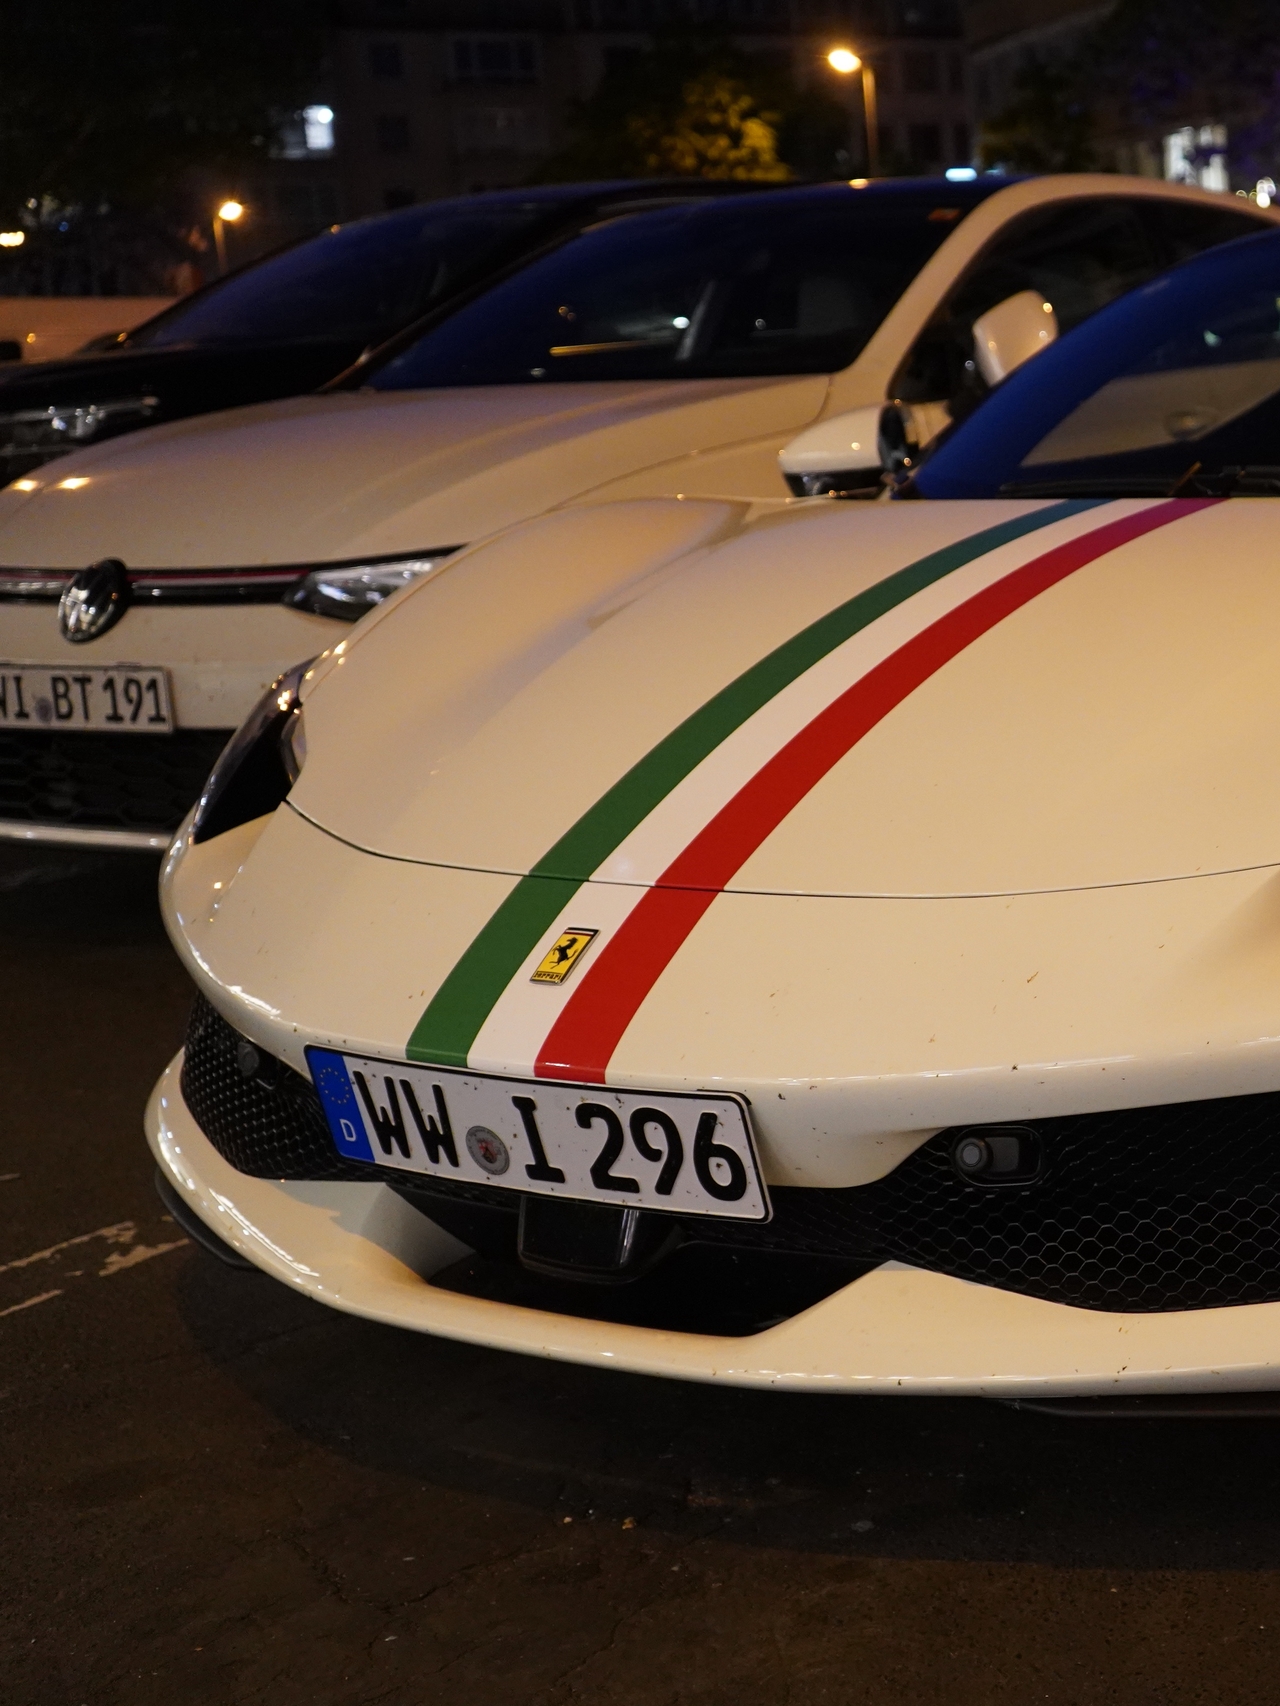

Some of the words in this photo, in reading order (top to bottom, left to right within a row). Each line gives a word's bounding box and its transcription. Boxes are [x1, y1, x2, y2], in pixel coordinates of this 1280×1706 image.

[51, 676, 92, 722] BT
[102, 676, 167, 722] 191
[338, 1118, 357, 1142] D
[352, 1070, 459, 1167] WW
[575, 1102, 748, 1201] 296
